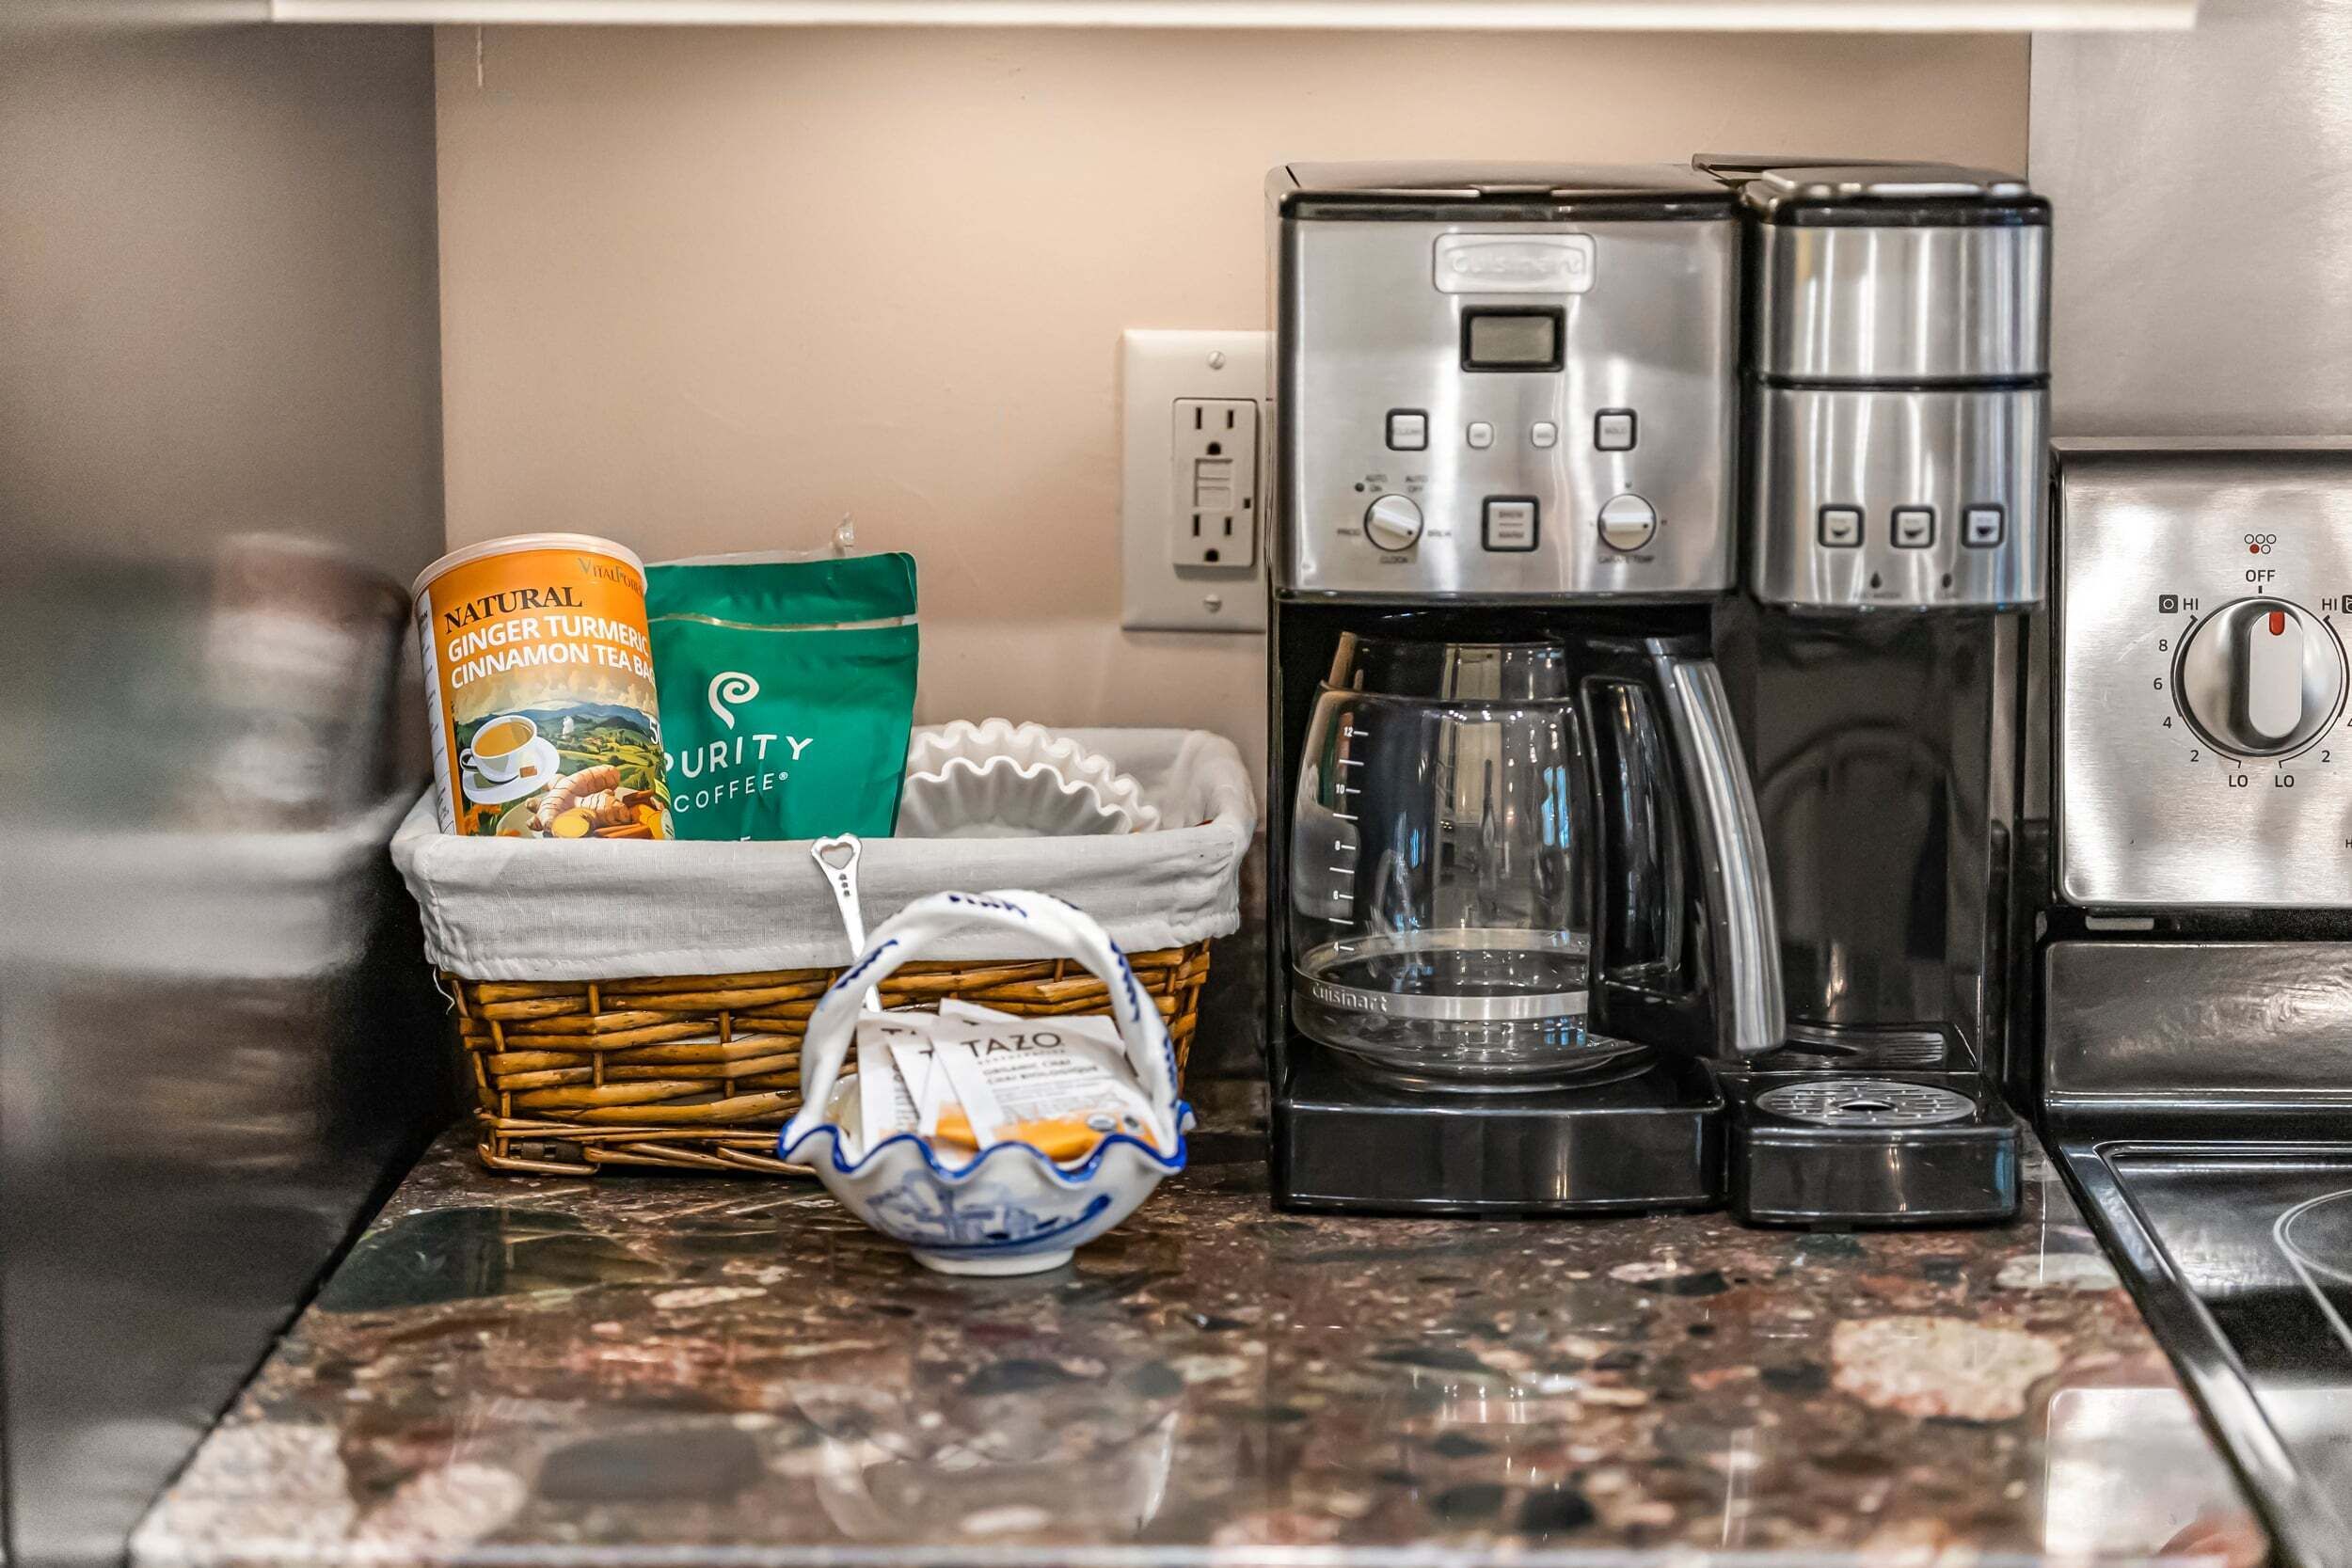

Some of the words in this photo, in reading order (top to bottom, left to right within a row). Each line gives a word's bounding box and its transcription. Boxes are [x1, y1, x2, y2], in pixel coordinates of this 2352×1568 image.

[2245, 569, 2276, 582] OFF
[444, 586, 582, 635] NATURAL
[2183, 598, 2199, 610] HI
[2321, 598, 2337, 611] HI
[448, 617, 541, 663] GINGER
[544, 615, 649, 658] TURMERIC
[2158, 639, 2169, 652] 8
[452, 642, 593, 689] CINNAMON
[592, 643, 632, 672] TEA
[2153, 677, 2163, 690] 6
[2162, 717, 2172, 730] 4
[1343, 726, 1354, 737] 12
[2189, 750, 2200, 763] 2
[2321, 750, 2330, 763] 2
[2228, 775, 2249, 788] LO
[2275, 775, 2295, 788] LO
[1336, 784, 1345, 795] 10
[1333, 941, 1340, 952] 4
[960, 1032, 1061, 1057] TAZO
